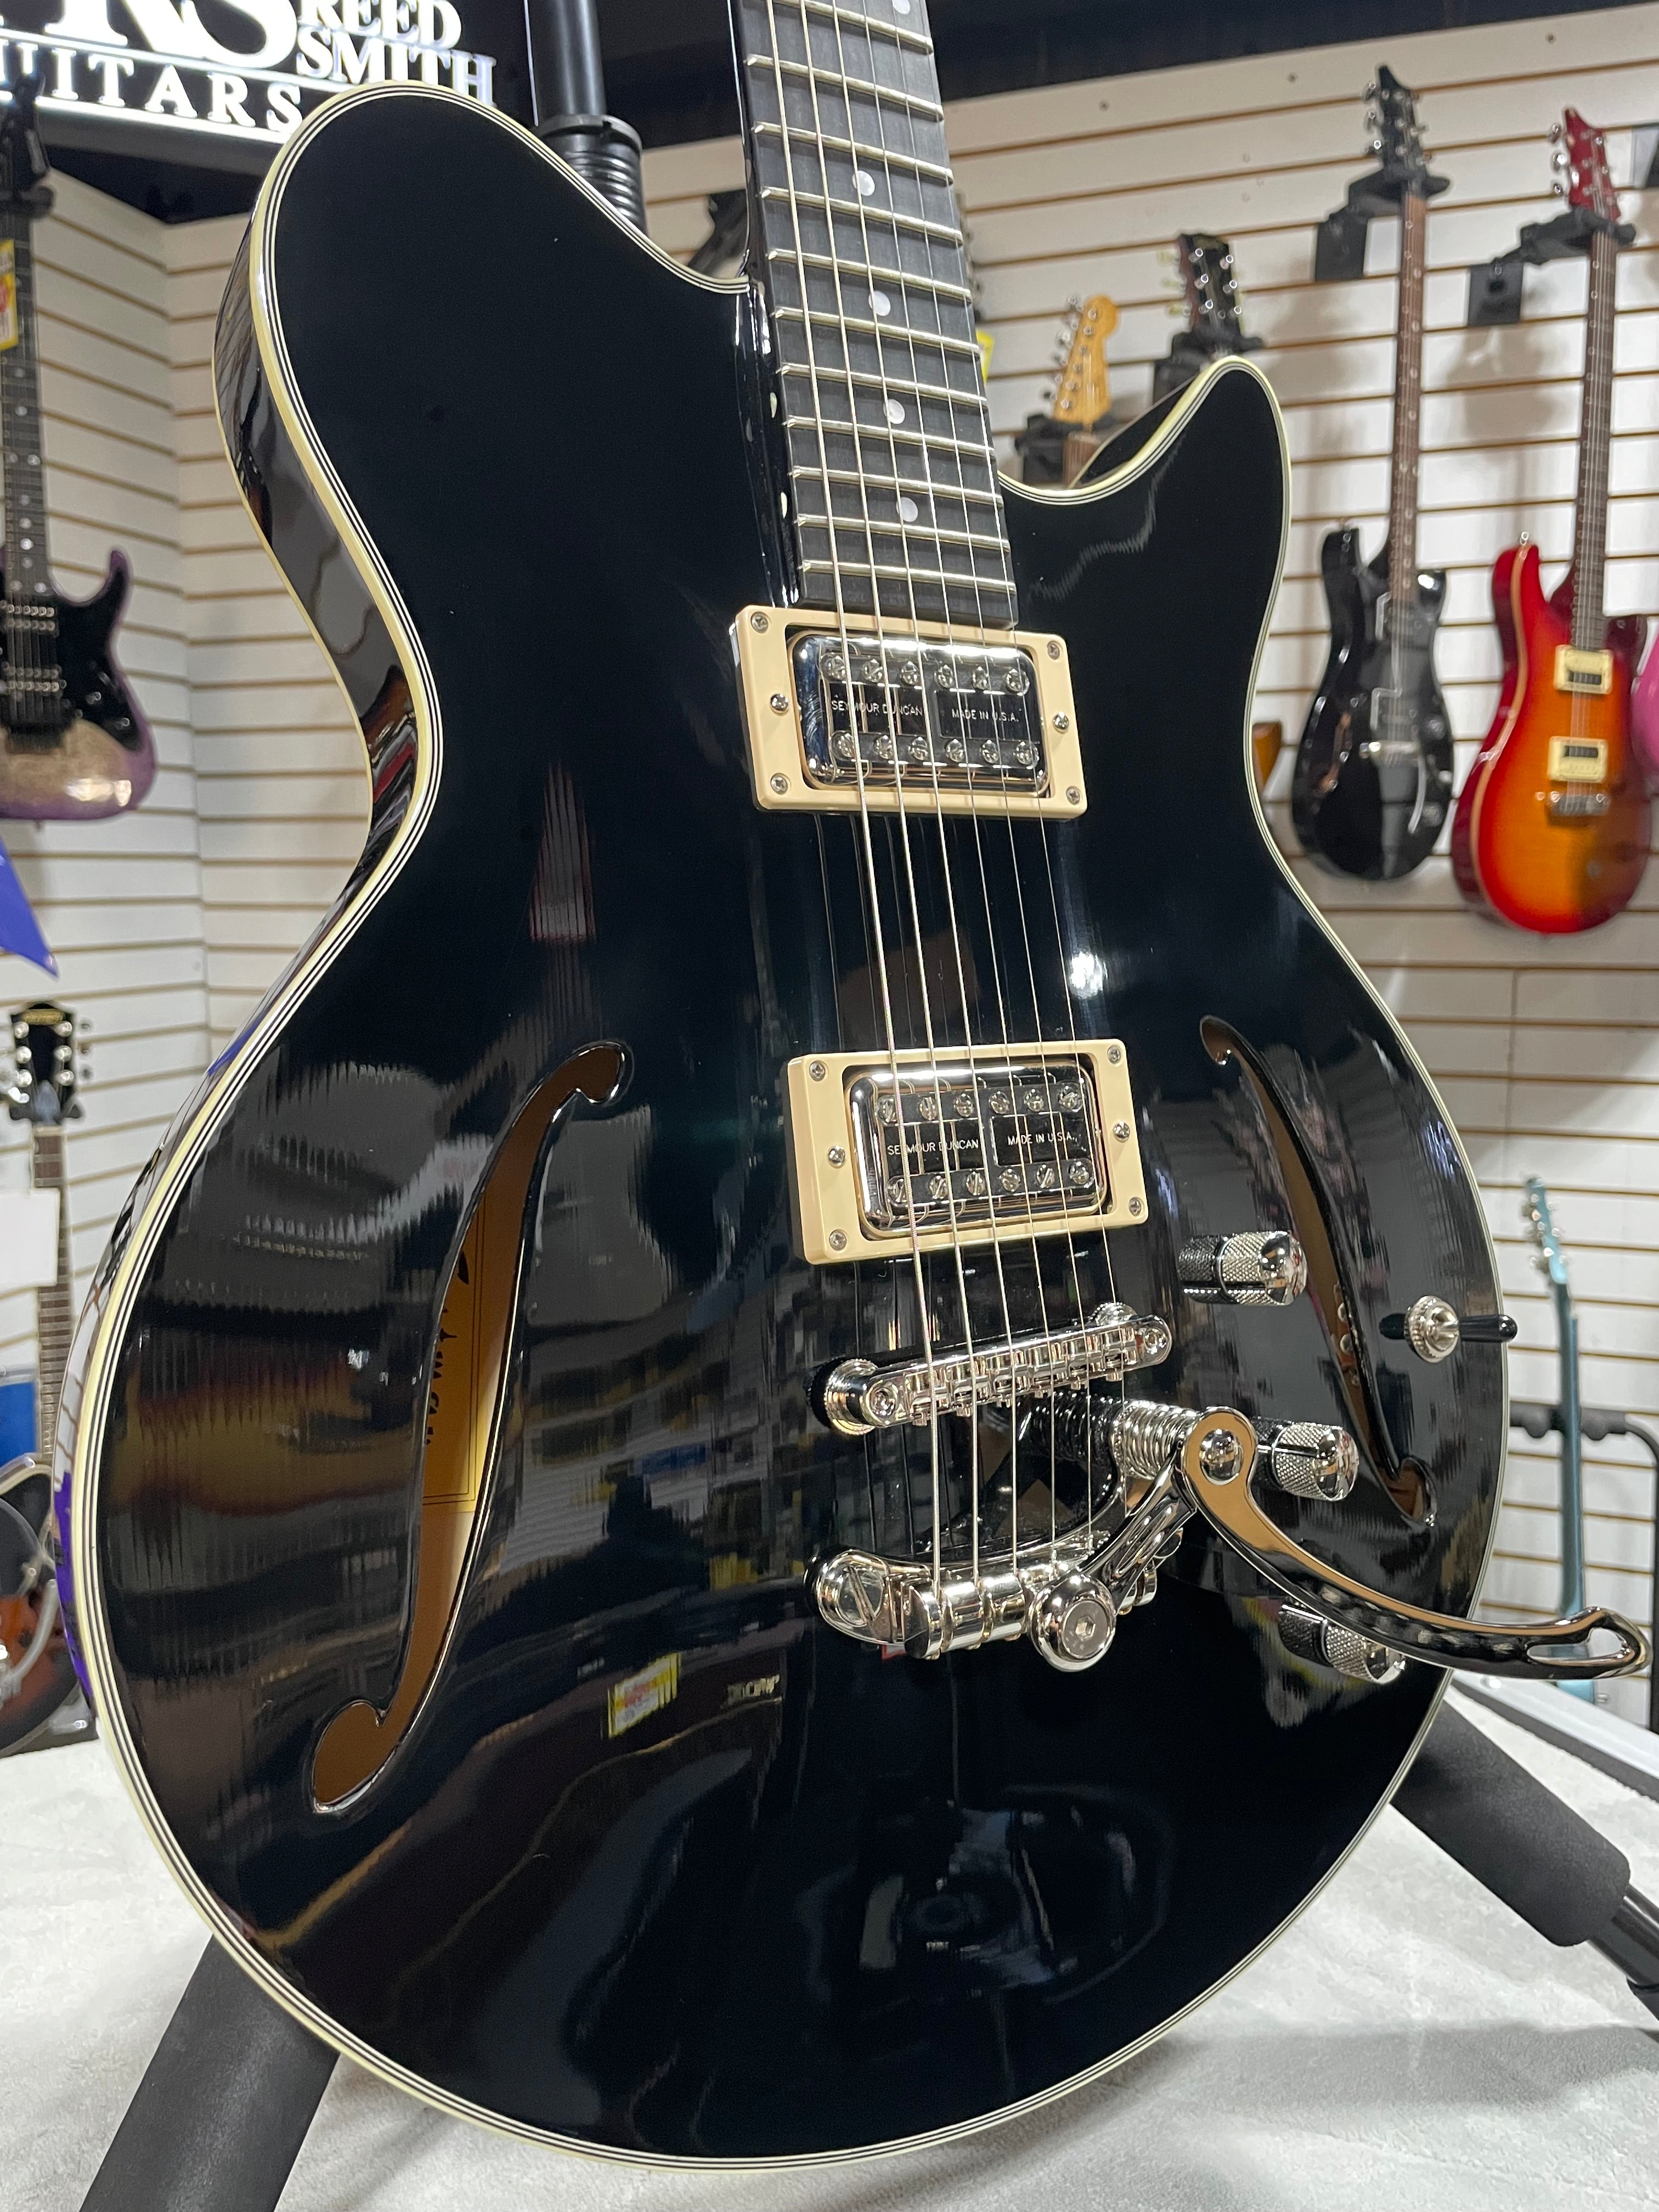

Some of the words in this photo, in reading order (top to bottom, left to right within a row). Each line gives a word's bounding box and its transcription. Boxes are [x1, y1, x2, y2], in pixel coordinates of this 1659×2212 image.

[296, 26, 497, 108] SMITH
[979, 710, 989, 720] IN
[1035, 1133, 1045, 1143] IN
[887, 1142, 936, 1155] SEMOUR
